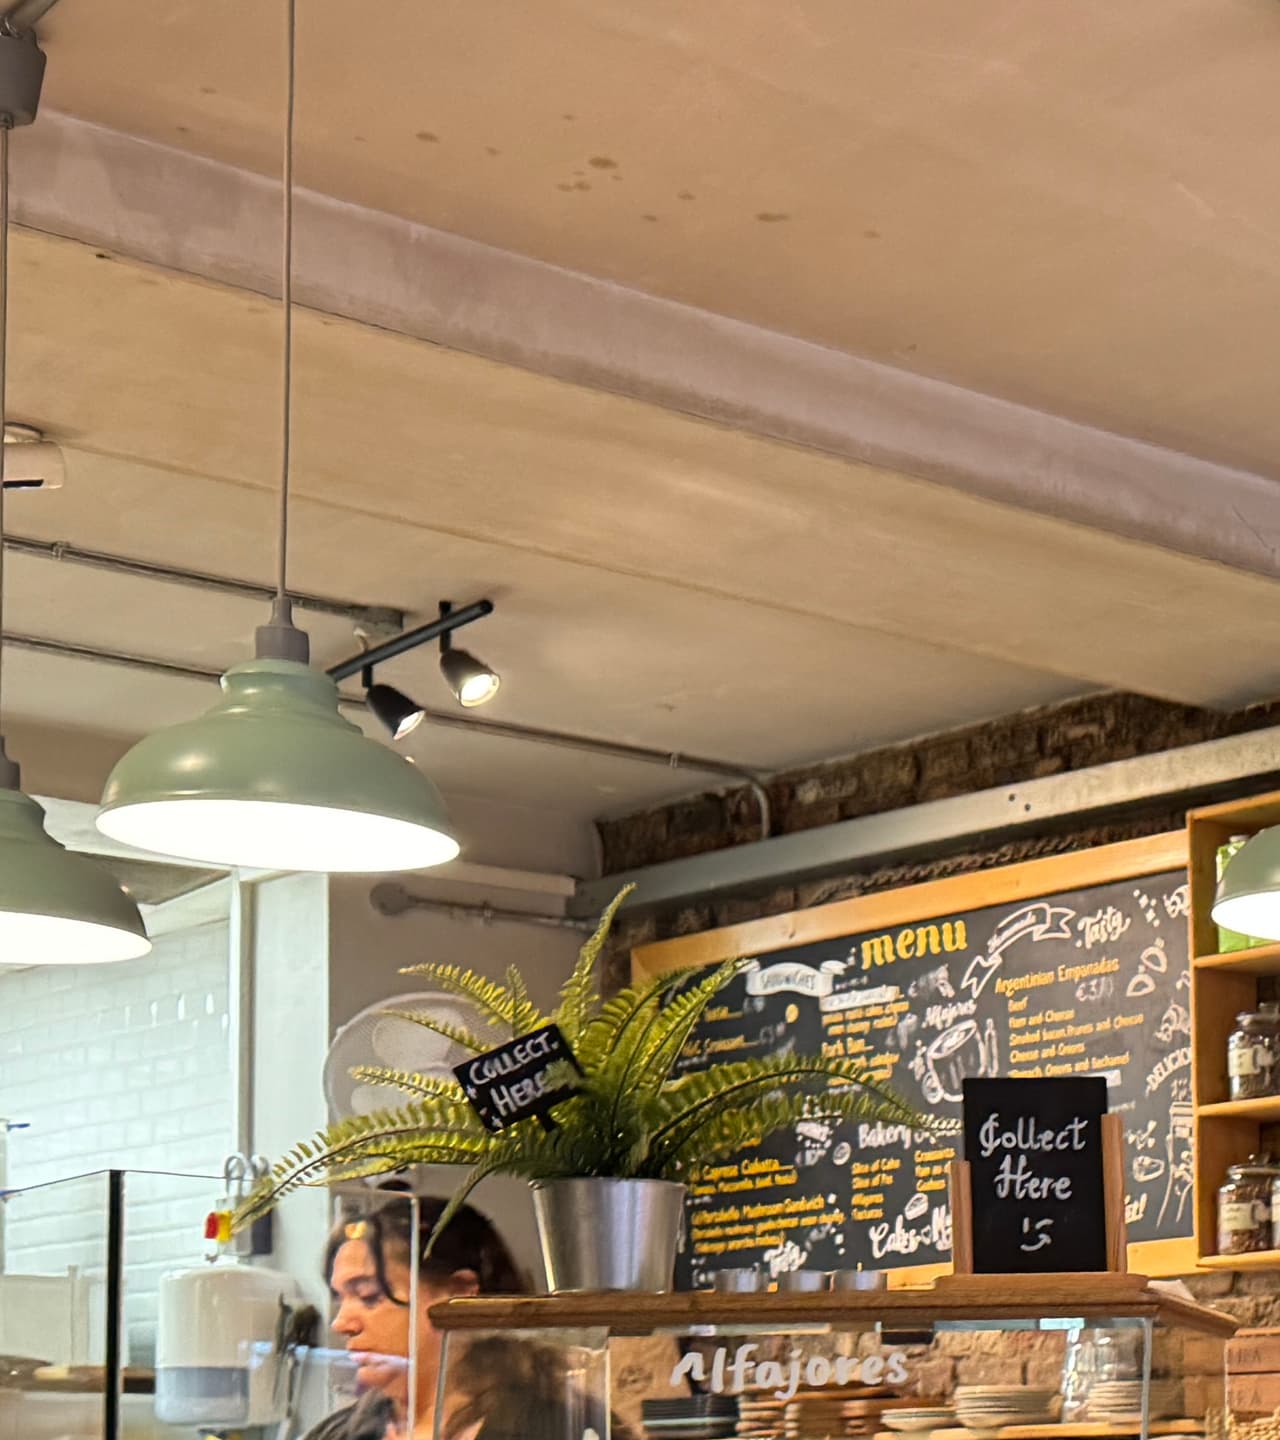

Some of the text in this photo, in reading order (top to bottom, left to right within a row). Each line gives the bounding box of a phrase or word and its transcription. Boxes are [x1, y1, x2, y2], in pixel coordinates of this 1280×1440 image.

[860, 919, 967, 971] menu
[994, 956, 1121, 998] Argentinian Empanadas
[468, 1030, 550, 1087] COLLECT
[858, 1120, 912, 1150] Bakery
[979, 1112, 1088, 1157] Collect
[994, 1154, 1073, 1200] Here
[669, 1343, 909, 1400] Alfajores
